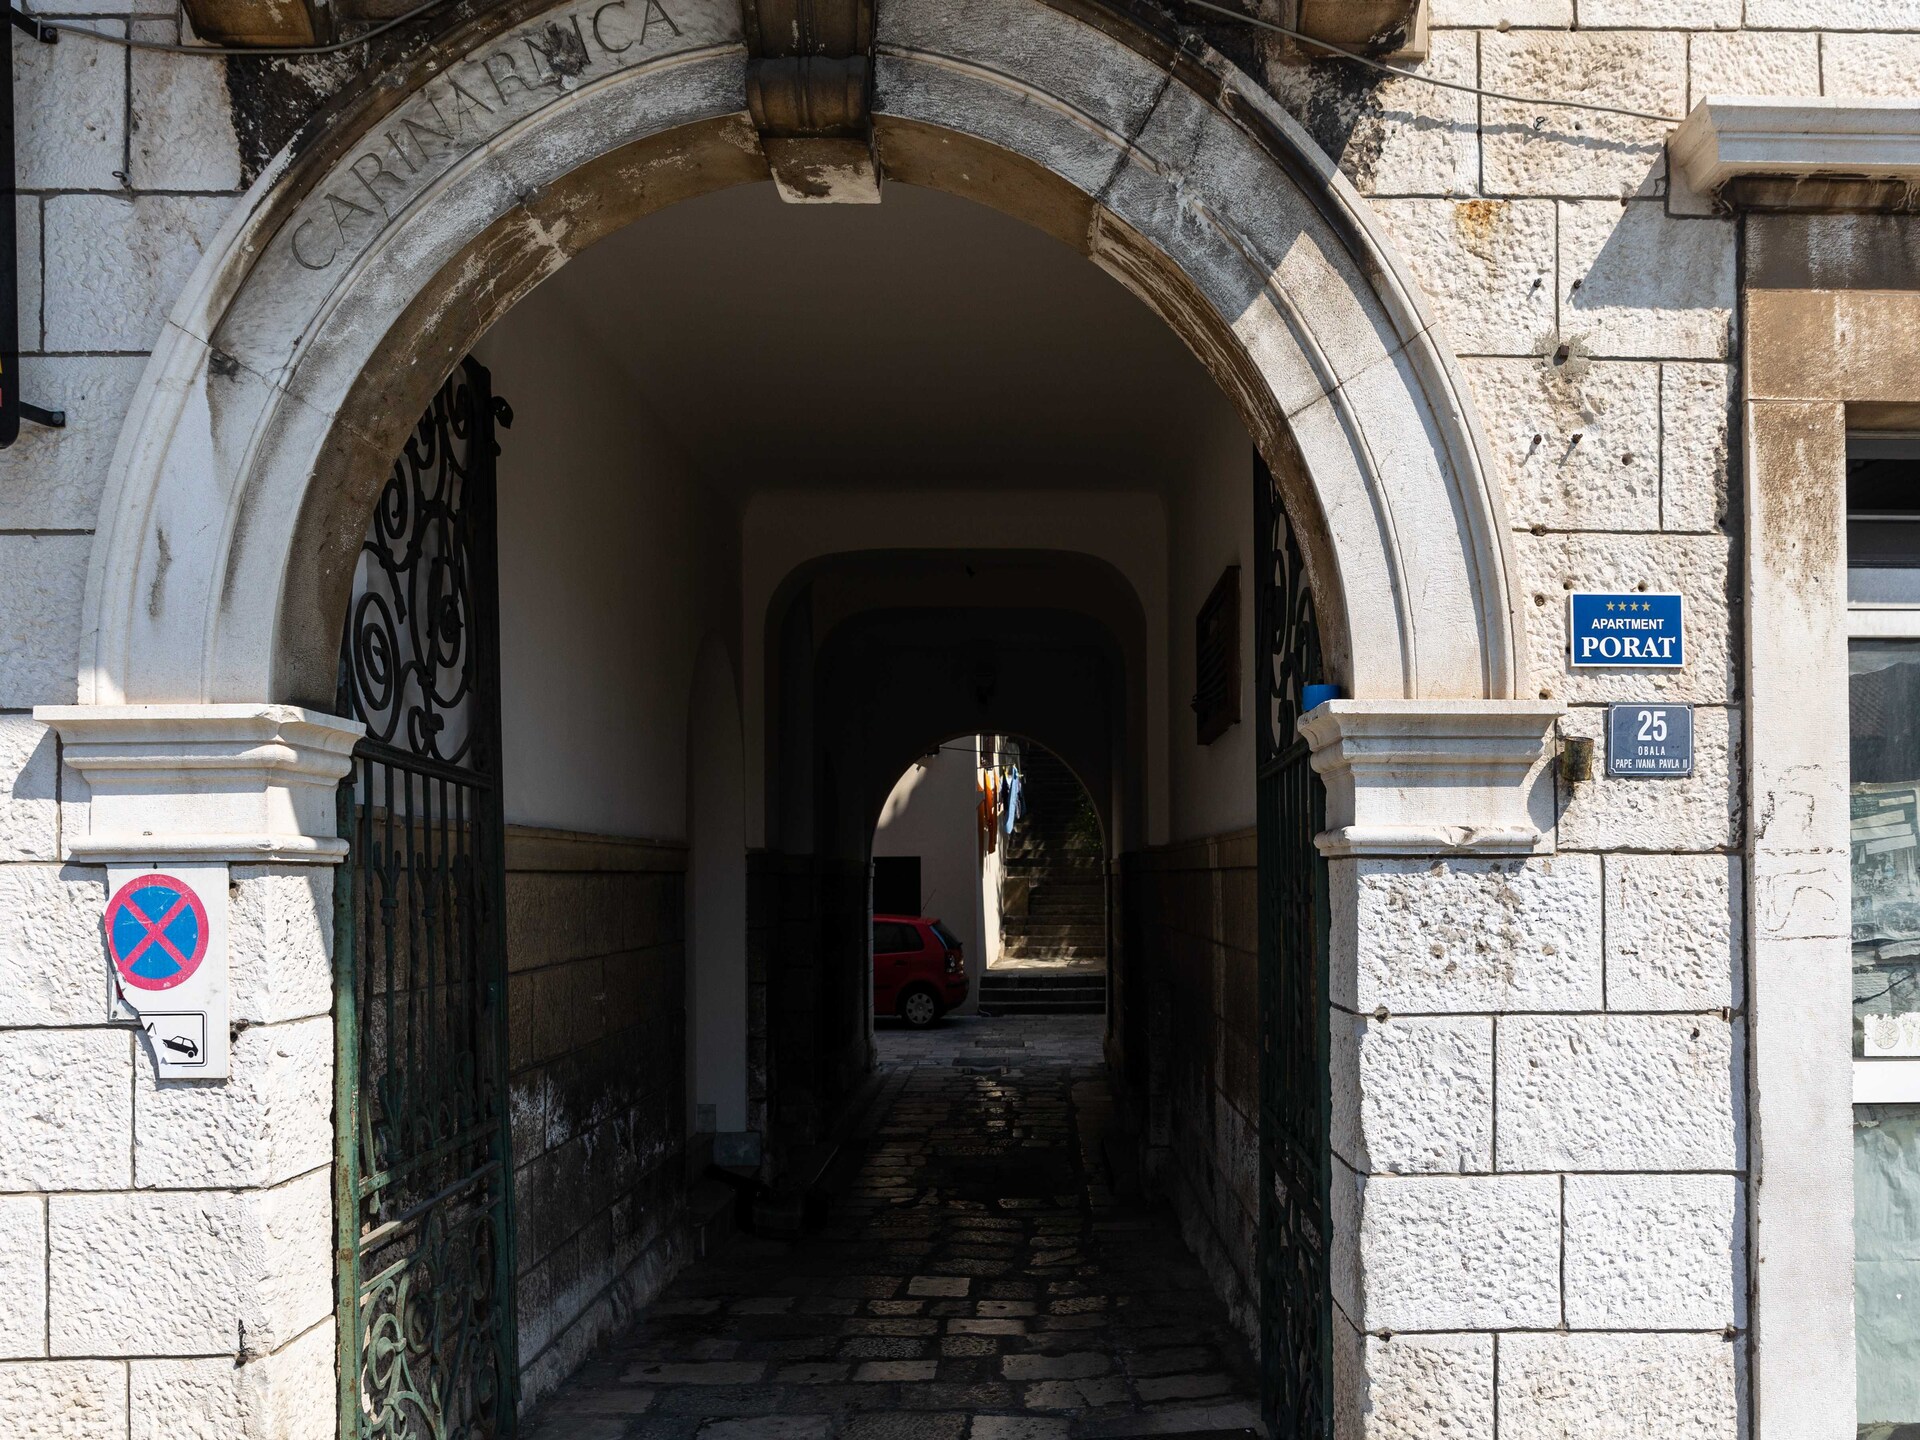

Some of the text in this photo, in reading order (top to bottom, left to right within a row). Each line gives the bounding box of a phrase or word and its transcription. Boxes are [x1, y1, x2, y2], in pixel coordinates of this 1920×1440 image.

[1592, 618, 1664, 629] APARTMENT
[1581, 636, 1676, 658] PORAT
[1637, 710, 1668, 741] 25
[1637, 745, 1666, 756] OBALA
[1615, 758, 1633, 768] PAPE
[1635, 758, 1656, 768] IVANA
[1659, 758, 1680, 768] PAVLA
